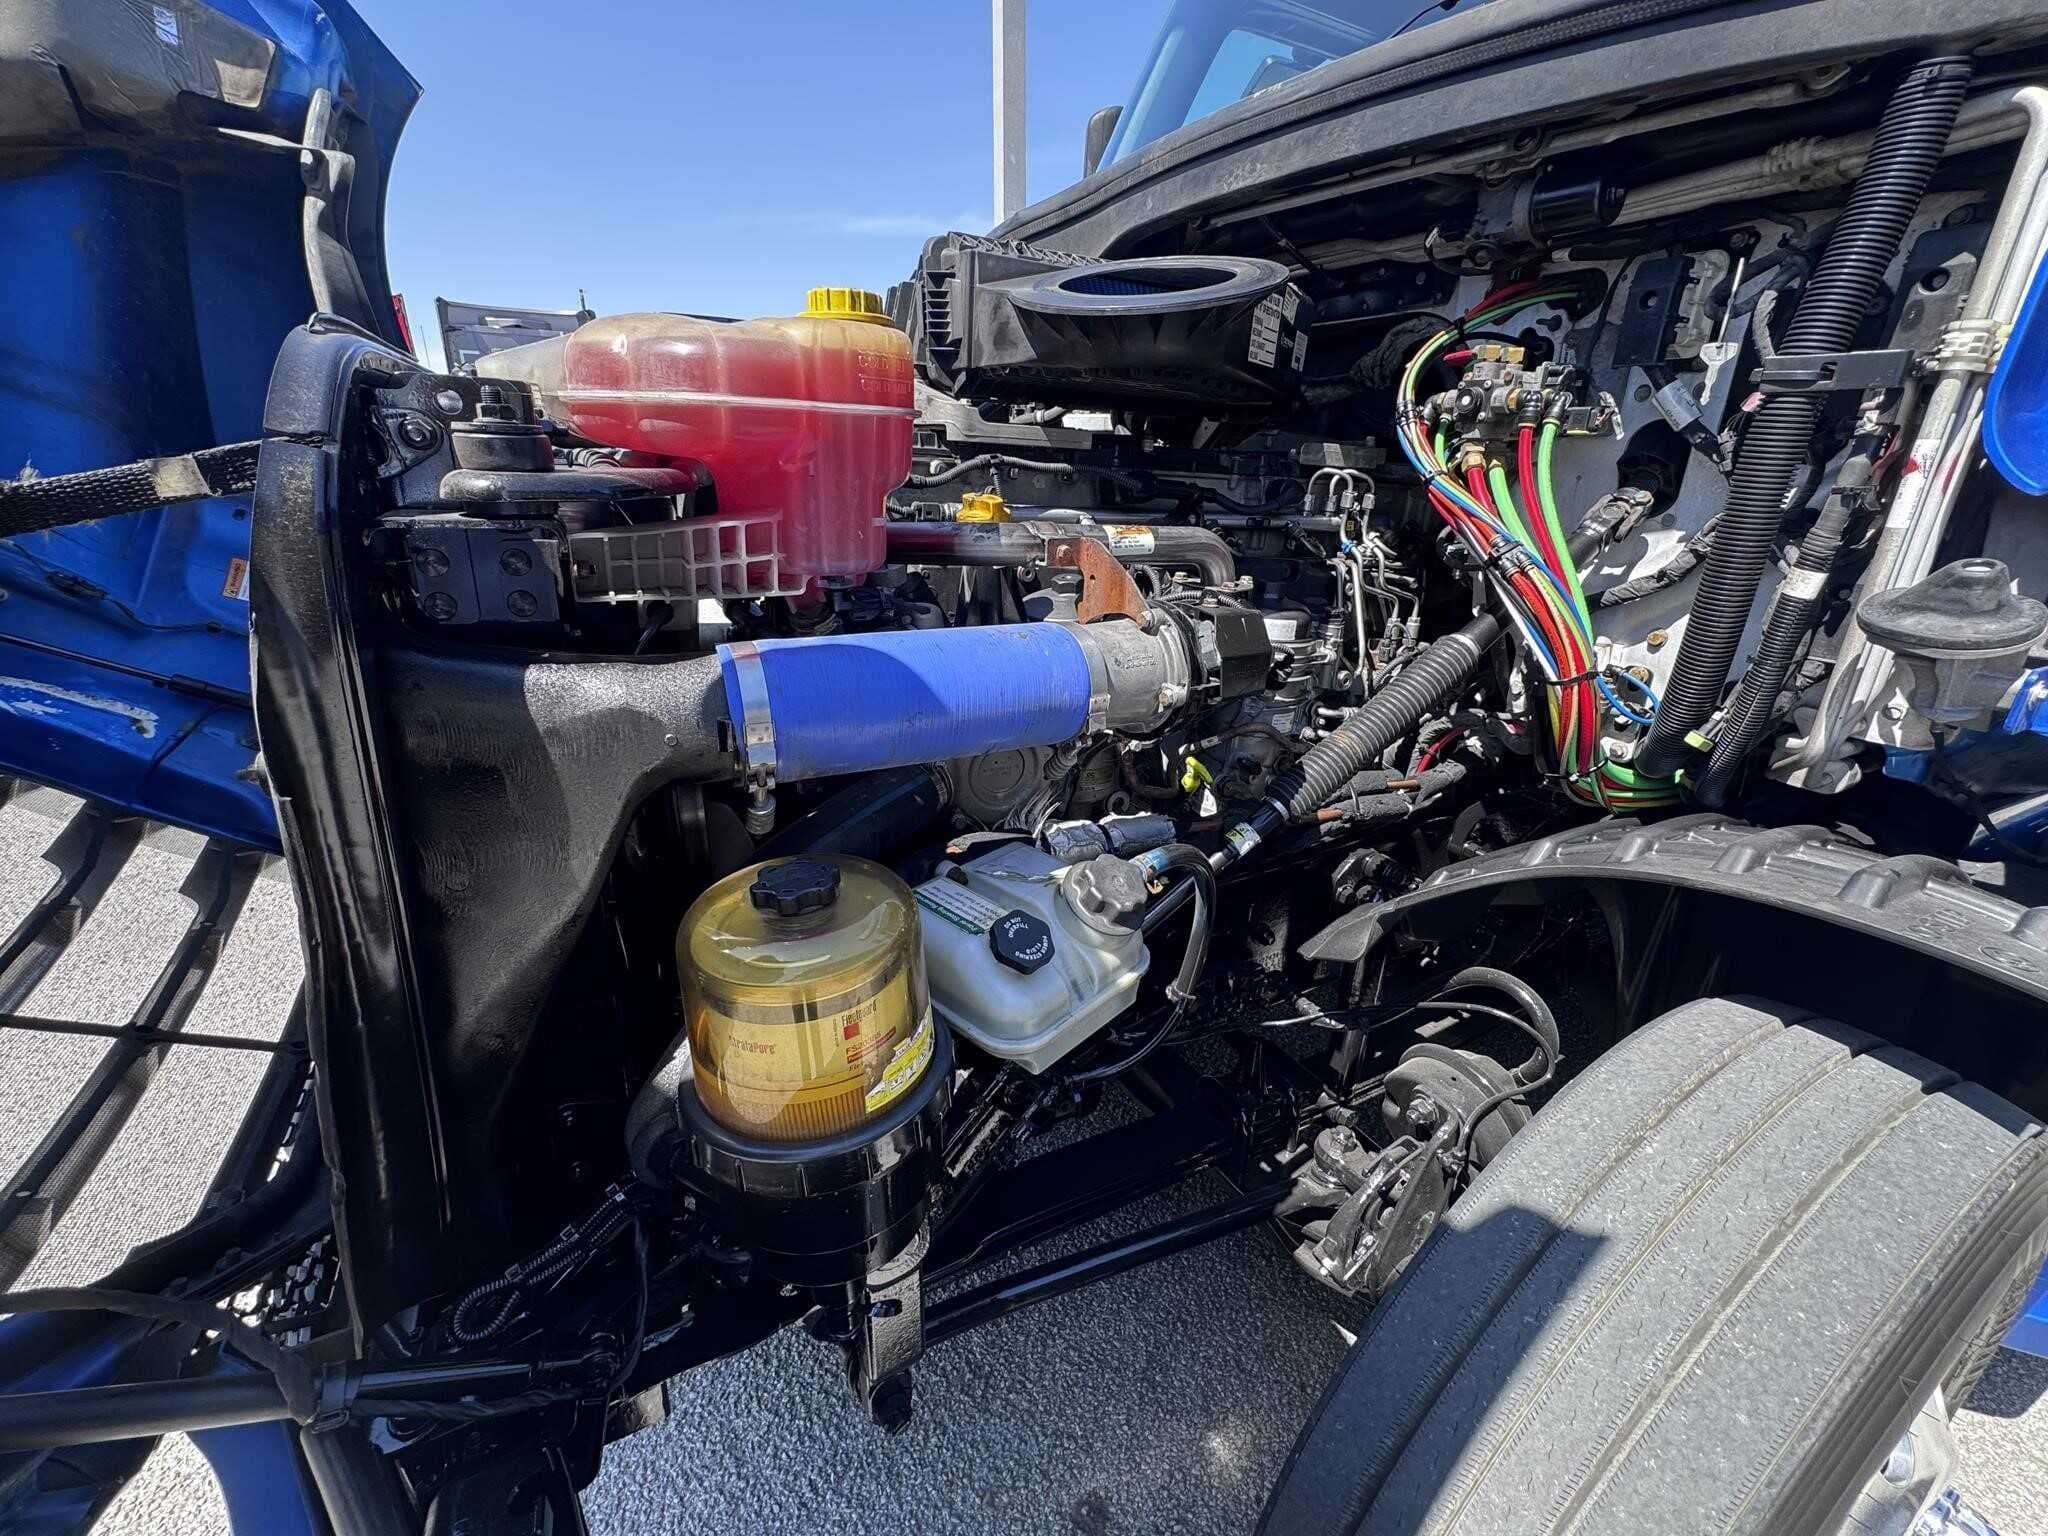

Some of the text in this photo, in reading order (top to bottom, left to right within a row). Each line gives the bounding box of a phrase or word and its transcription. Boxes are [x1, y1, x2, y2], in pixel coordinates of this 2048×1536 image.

[1010, 916, 1022, 924] NOT
[1008, 922, 1029, 939] OVERFILL
[1014, 935, 1049, 961] POWER STEERING
